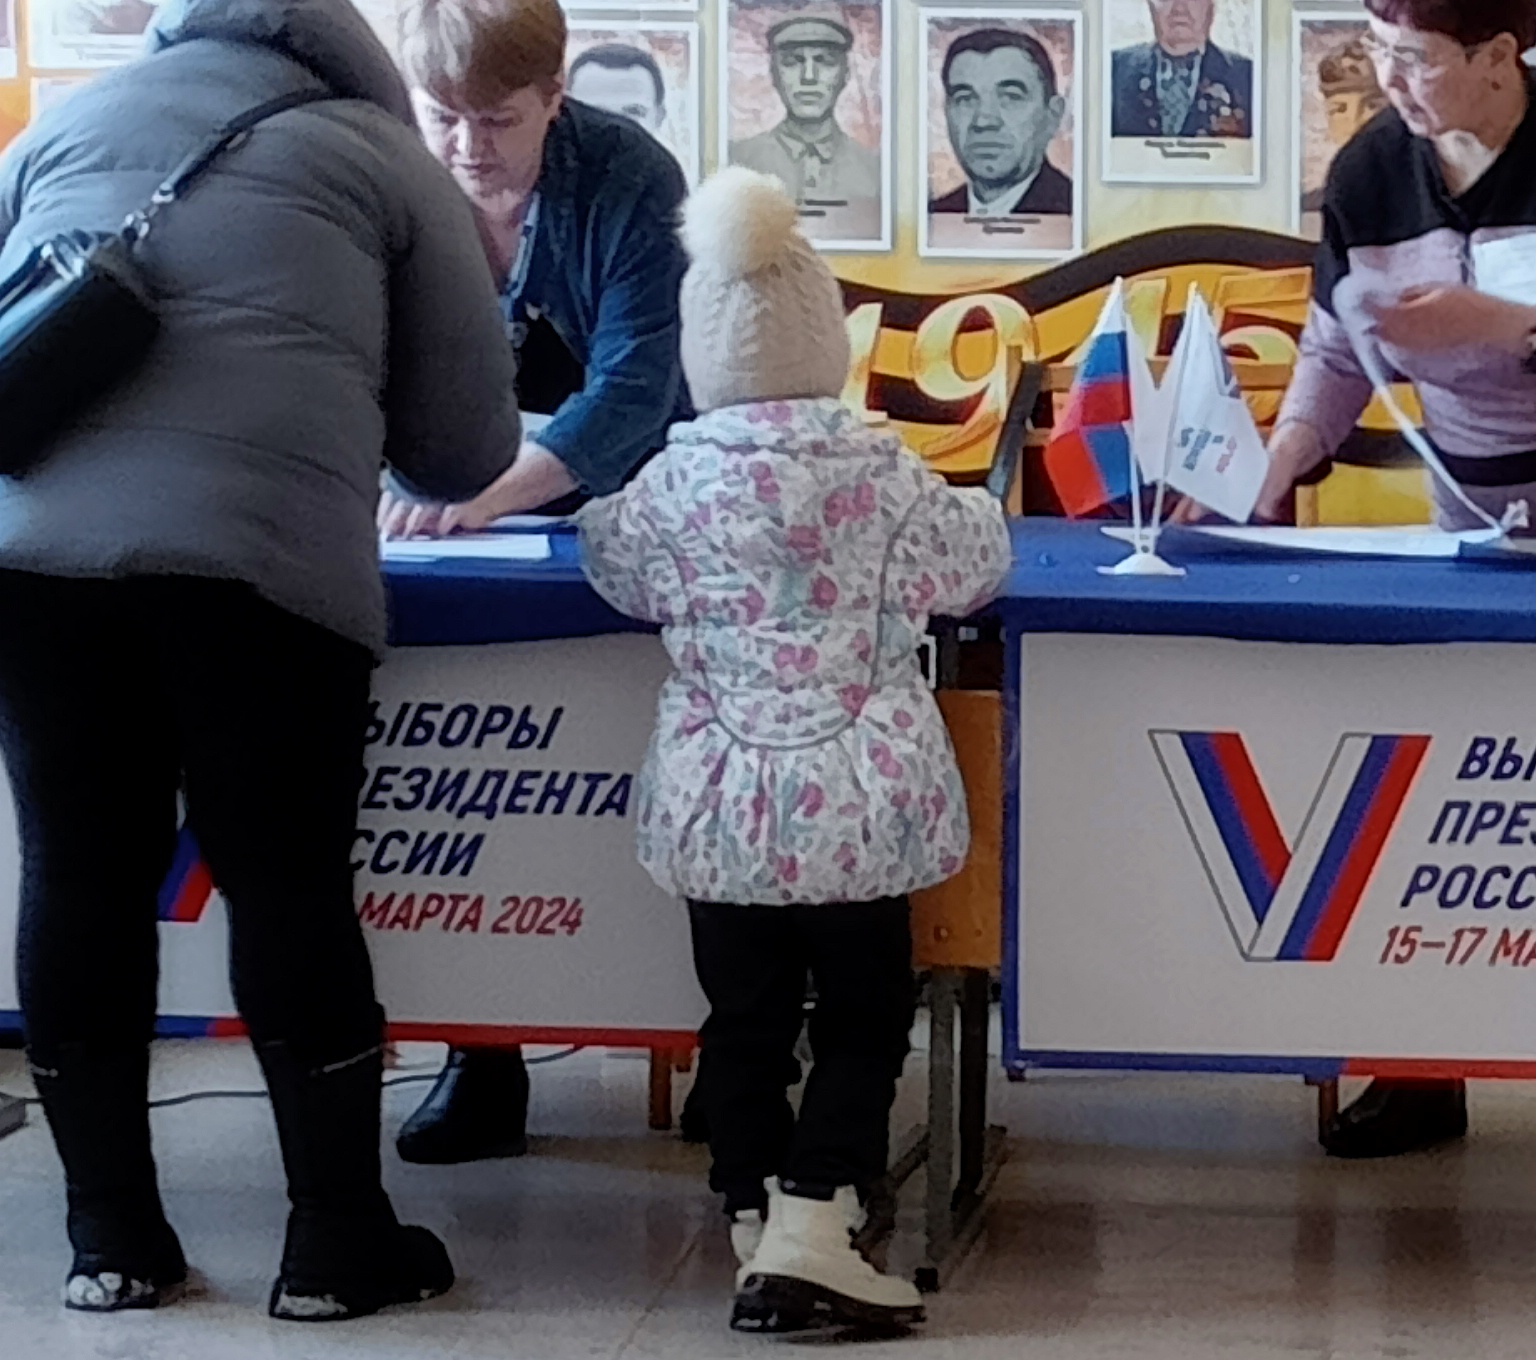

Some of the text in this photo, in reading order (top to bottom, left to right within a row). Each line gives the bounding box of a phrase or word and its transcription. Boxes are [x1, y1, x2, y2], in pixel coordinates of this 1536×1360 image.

[363, 700, 564, 751] ЫБОРЫ
[360, 765, 633, 820] ЕЗИДЕНТА
[358, 891, 584, 936] МАРТА 2024
